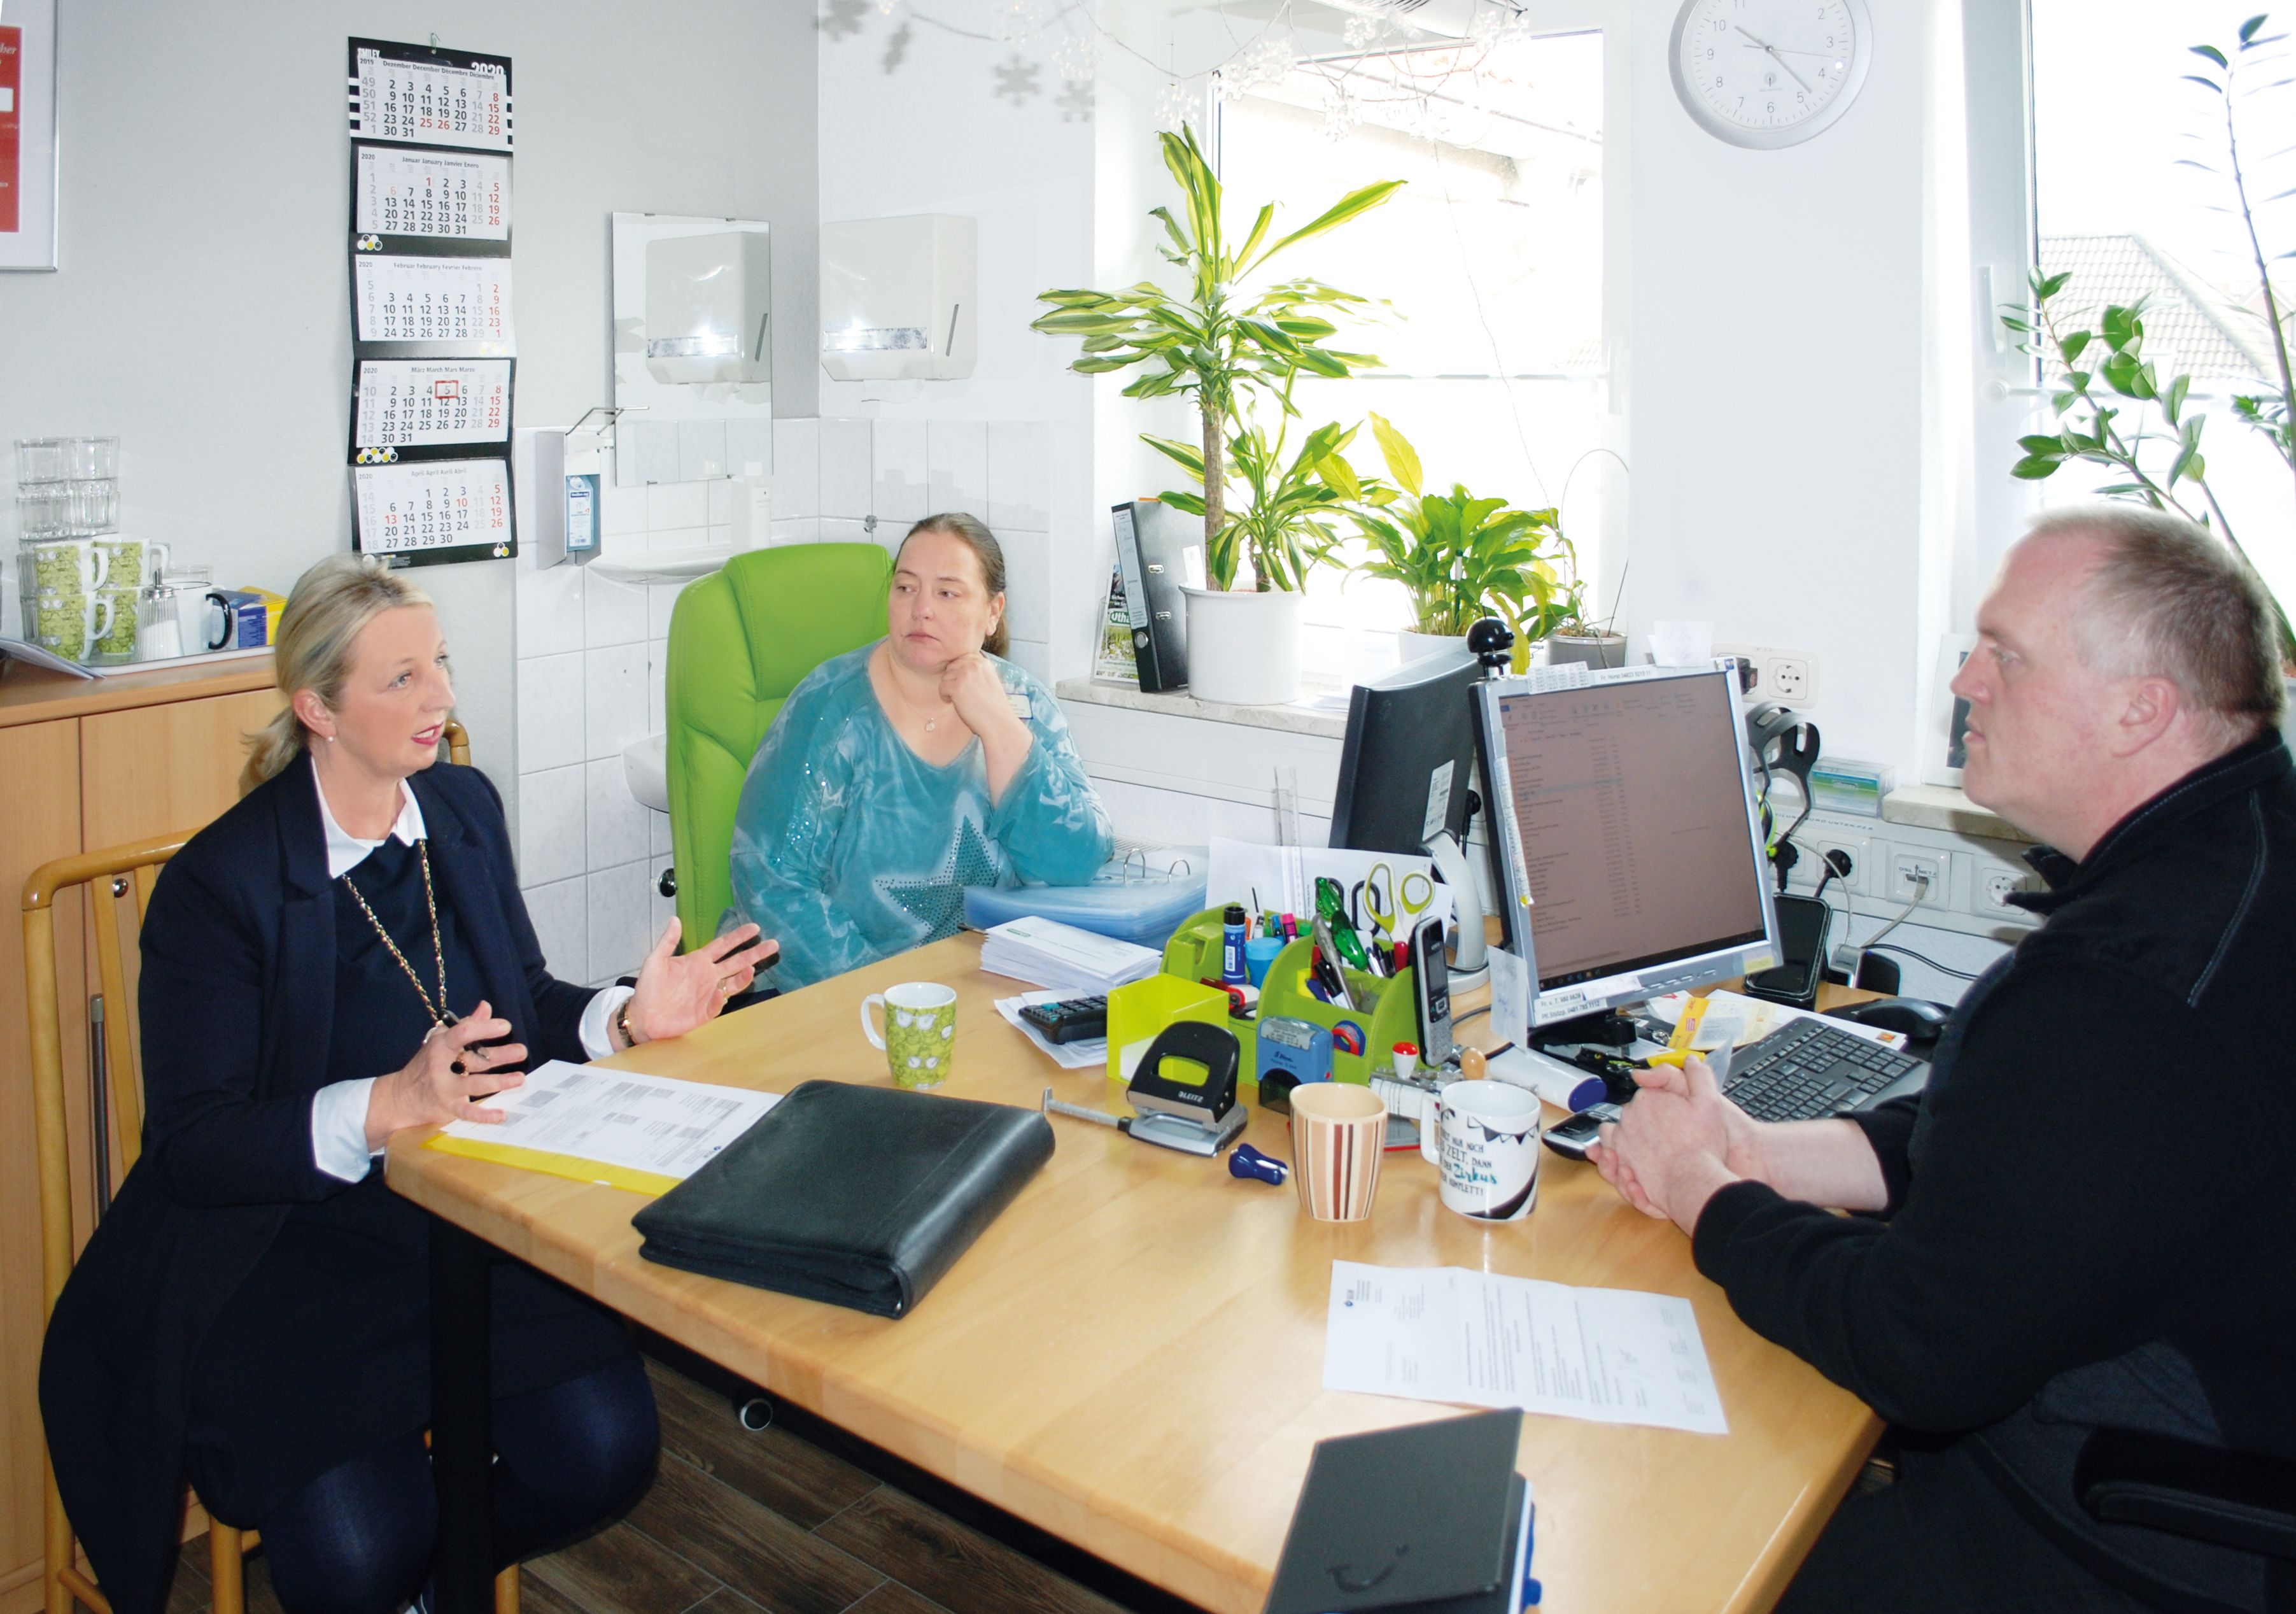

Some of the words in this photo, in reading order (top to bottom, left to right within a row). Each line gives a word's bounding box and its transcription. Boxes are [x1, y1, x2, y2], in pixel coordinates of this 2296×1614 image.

[1817, 8, 1825, 20] 2
[1714, 20, 1726, 31] 10
[1826, 36, 1834, 48] 3
[357, 48, 380, 58] SMILEY
[1707, 48, 1714, 60] 9
[383, 60, 411, 69] Dezember
[412, 64, 440, 73] December
[471, 62, 505, 74] 2020
[1818, 68, 1825, 78] 4
[1716, 76, 1723, 88] 8
[390, 80, 395, 89] 2
[408, 81, 413, 91] 3
[426, 84, 432, 93] 4
[444, 86, 449, 95] 5
[460, 88, 466, 97] 6
[493, 93, 498, 102] 8
[390, 91, 396, 101] 9
[402, 93, 414, 103] 10
[421, 95, 431, 104] 11
[438, 97, 449, 106] 12
[456, 99, 466, 108] 13
[489, 104, 499, 113] 15
[1738, 97, 1744, 108] 7
[1797, 92, 1804, 103] 5
[384, 103, 396, 112] 16
[403, 104, 414, 114] 17
[421, 106, 432, 116] 18
[439, 108, 449, 118] 19
[455, 110, 467, 120] 20
[488, 114, 499, 124] 22
[1767, 102, 1775, 113] 6
[384, 114, 397, 124] 23
[402, 116, 414, 125] 24
[420, 118, 432, 127] 25
[438, 120, 449, 130] 26
[455, 122, 467, 131] 27
[489, 125, 500, 135] 29
[384, 125, 397, 136] 30
[403, 127, 414, 137] 31
[426, 178, 430, 186] 1
[444, 178, 449, 187] 2
[461, 180, 466, 189] 3
[494, 183, 499, 192] 5
[390, 187, 397, 195] 6
[408, 187, 414, 196] 7
[426, 188, 432, 197] 8
[444, 190, 449, 199] 9
[455, 191, 466, 200] 10
[489, 194, 498, 202] 12
[385, 197, 397, 207] 13
[404, 199, 415, 208] 14
[421, 200, 432, 209] 15
[439, 201, 449, 210] 16
[456, 202, 466, 211] 17
[489, 205, 499, 214] 19
[385, 209, 397, 218] 20
[404, 210, 414, 220] 21
[421, 211, 432, 221] 22
[439, 212, 449, 222] 23
[455, 213, 467, 223] 24
[489, 216, 499, 225] 26
[386, 221, 397, 230] 27
[404, 222, 415, 231] 28
[421, 223, 433, 232] 29
[438, 224, 450, 233] 30
[455, 225, 466, 234] 31
[494, 284, 498, 293] 2
[389, 293, 395, 302] 3
[407, 294, 412, 302] 4
[425, 294, 430, 302] 5
[443, 294, 448, 302] 6
[460, 294, 465, 303] 7
[494, 295, 499, 304] 9
[391, 386, 397, 395] 2
[409, 386, 414, 395] 3
[426, 386, 432, 395] 4
[445, 385, 451, 395] 5
[462, 385, 467, 394] 6
[384, 410, 395, 419] 16
[403, 409, 414, 418] 17
[421, 409, 432, 418] 18
[439, 409, 449, 418] 19
[454, 408, 467, 417] 20
[489, 407, 500, 416] 22
[426, 489, 430, 497] 1
[443, 488, 449, 497] 2
[461, 486, 466, 495] 3
[495, 485, 500, 493] 5
[390, 503, 396, 512] 6
[409, 502, 414, 511] 7
[426, 500, 432, 509] 8
[444, 499, 449, 508] 9
[456, 498, 467, 507] 10
[490, 496, 500, 504] 12
[1183, 1092, 1204, 1103] LEITZ
[1467, 1142, 1483, 1153] NOCH
[1472, 1157, 1492, 1168] DANN
[1453, 1163, 1497, 1184] Zirkus
